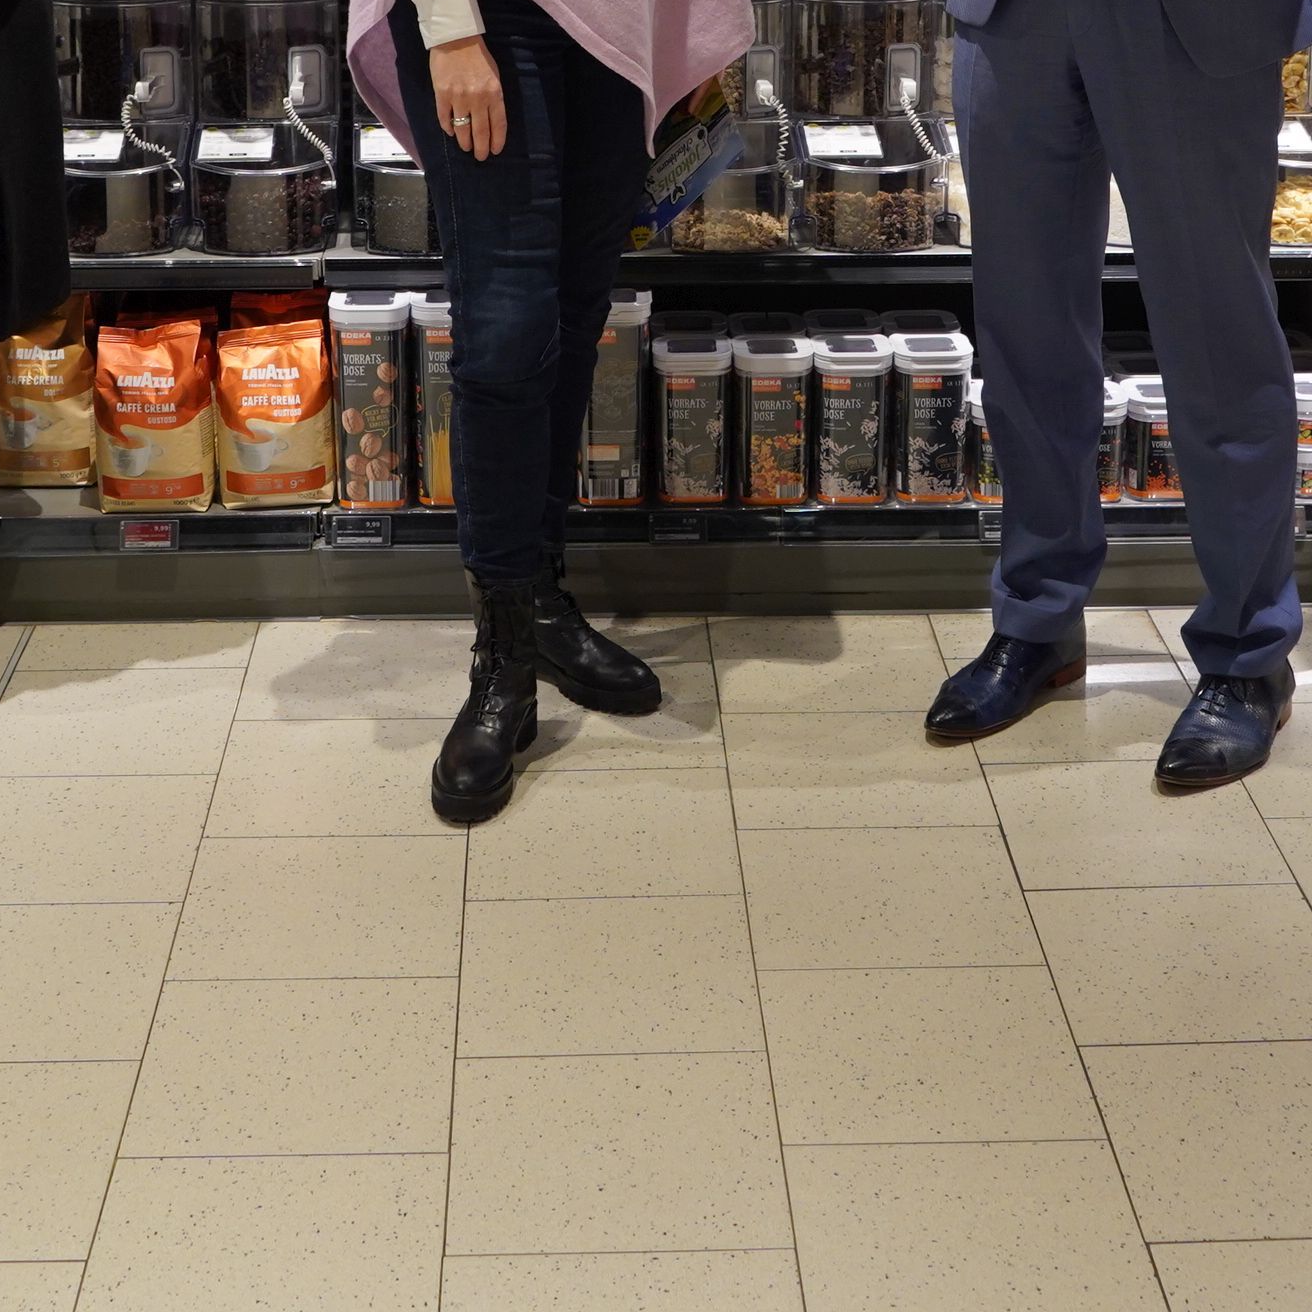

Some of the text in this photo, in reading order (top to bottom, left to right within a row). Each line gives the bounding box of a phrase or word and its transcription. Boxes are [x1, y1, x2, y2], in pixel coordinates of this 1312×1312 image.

[8, 345, 64, 360] LAVAZZA
[428, 351, 453, 362] VORR
[343, 353, 385, 365] VORRATS-
[241, 363, 299, 380] LAVAZZA
[343, 365, 365, 376] DOSE
[33, 375, 64, 385] CREMA
[116, 372, 175, 388] LAVAZZA
[823, 376, 851, 385] EDEKA
[912, 376, 943, 384] EDEKA
[242, 394, 301, 406] CAFFÈ CREMA
[668, 398, 709, 409] VORRATS-
[754, 400, 795, 410] VORRATS-
[823, 397, 864, 409] VORRATS-
[914, 397, 955, 408] VORRATS-
[116, 402, 176, 412] CAFFÈ CREMA
[273, 408, 301, 417] GUSTOSO
[668, 409, 689, 419] DOSE
[754, 411, 775, 421] DOSE
[823, 409, 845, 420] DOSE
[914, 408, 936, 419] DOSE
[147, 416, 177, 424] GUSTOSO
[1099, 444, 1111, 452] OSE
[1152, 440, 1172, 448] VORRA
